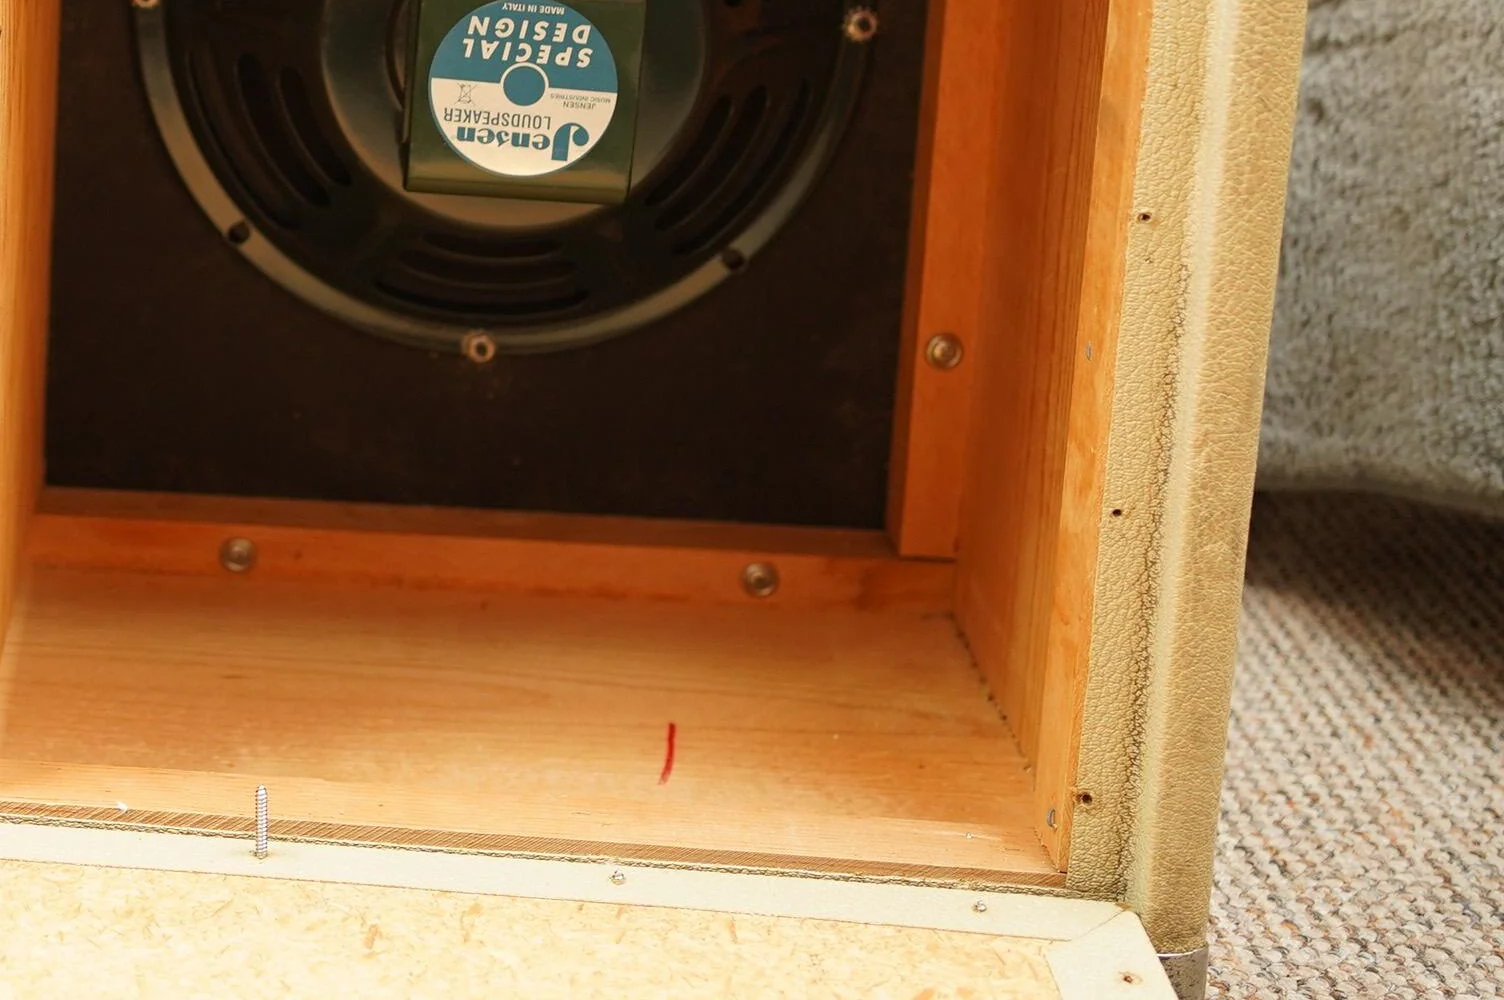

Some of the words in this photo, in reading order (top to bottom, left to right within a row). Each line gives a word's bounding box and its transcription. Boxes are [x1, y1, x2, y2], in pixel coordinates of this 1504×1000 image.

[502, 2, 525, 12] ITALY
[527, 5, 537, 13] IN
[539, 5, 564, 15] MADE
[468, 15, 591, 44] DESIGN
[463, 38, 593, 68] SPECIAL
[563, 101, 597, 109] JENSEN
[443, 107, 551, 130] LOUDSPEAKER
[457, 123, 589, 161] Jensen
